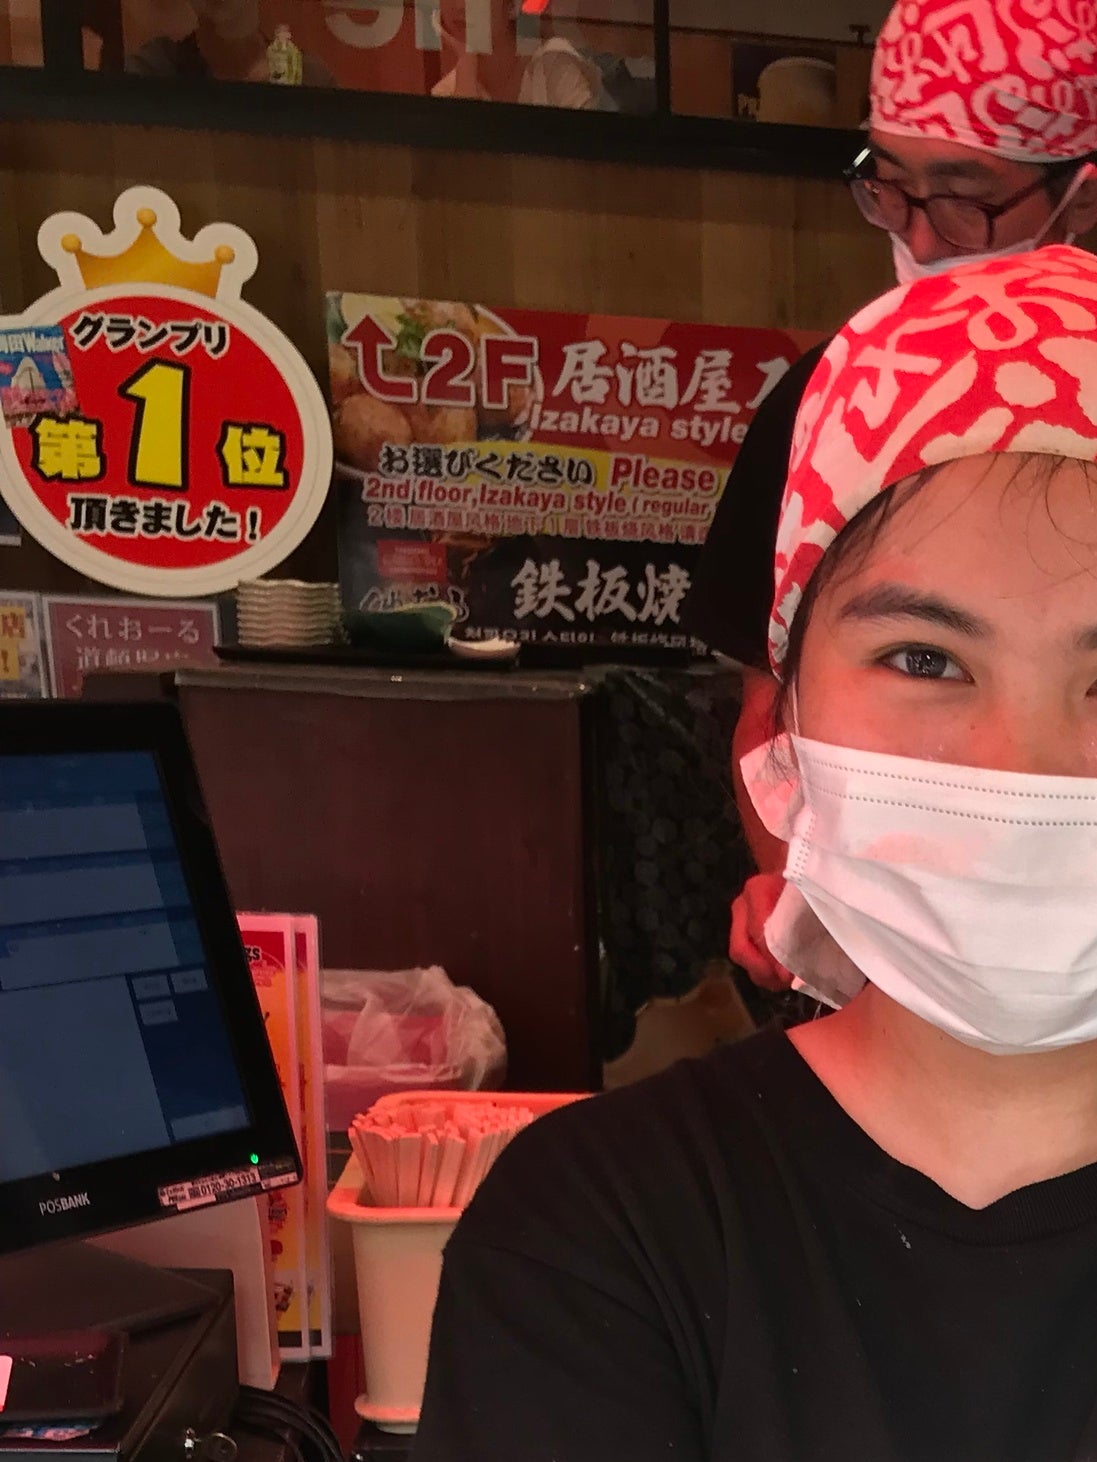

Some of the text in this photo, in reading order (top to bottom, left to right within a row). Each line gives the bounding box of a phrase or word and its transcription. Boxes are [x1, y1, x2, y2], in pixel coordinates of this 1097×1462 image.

[73, 315, 228, 356] グランプリ
[420, 328, 538, 411] 2F
[31, 357, 288, 490] 第1位
[529, 404, 749, 446] Izakaya style
[380, 444, 595, 486] お選びください
[610, 456, 717, 493] Please
[69, 496, 260, 541] 頂きました！
[365, 477, 410, 499] 2nd
[573, 490, 628, 518] style
[511, 558, 692, 625] 鉄板焼
[66, 614, 200, 645] くれおーる
[39, 1192, 90, 1216] POSBANK
